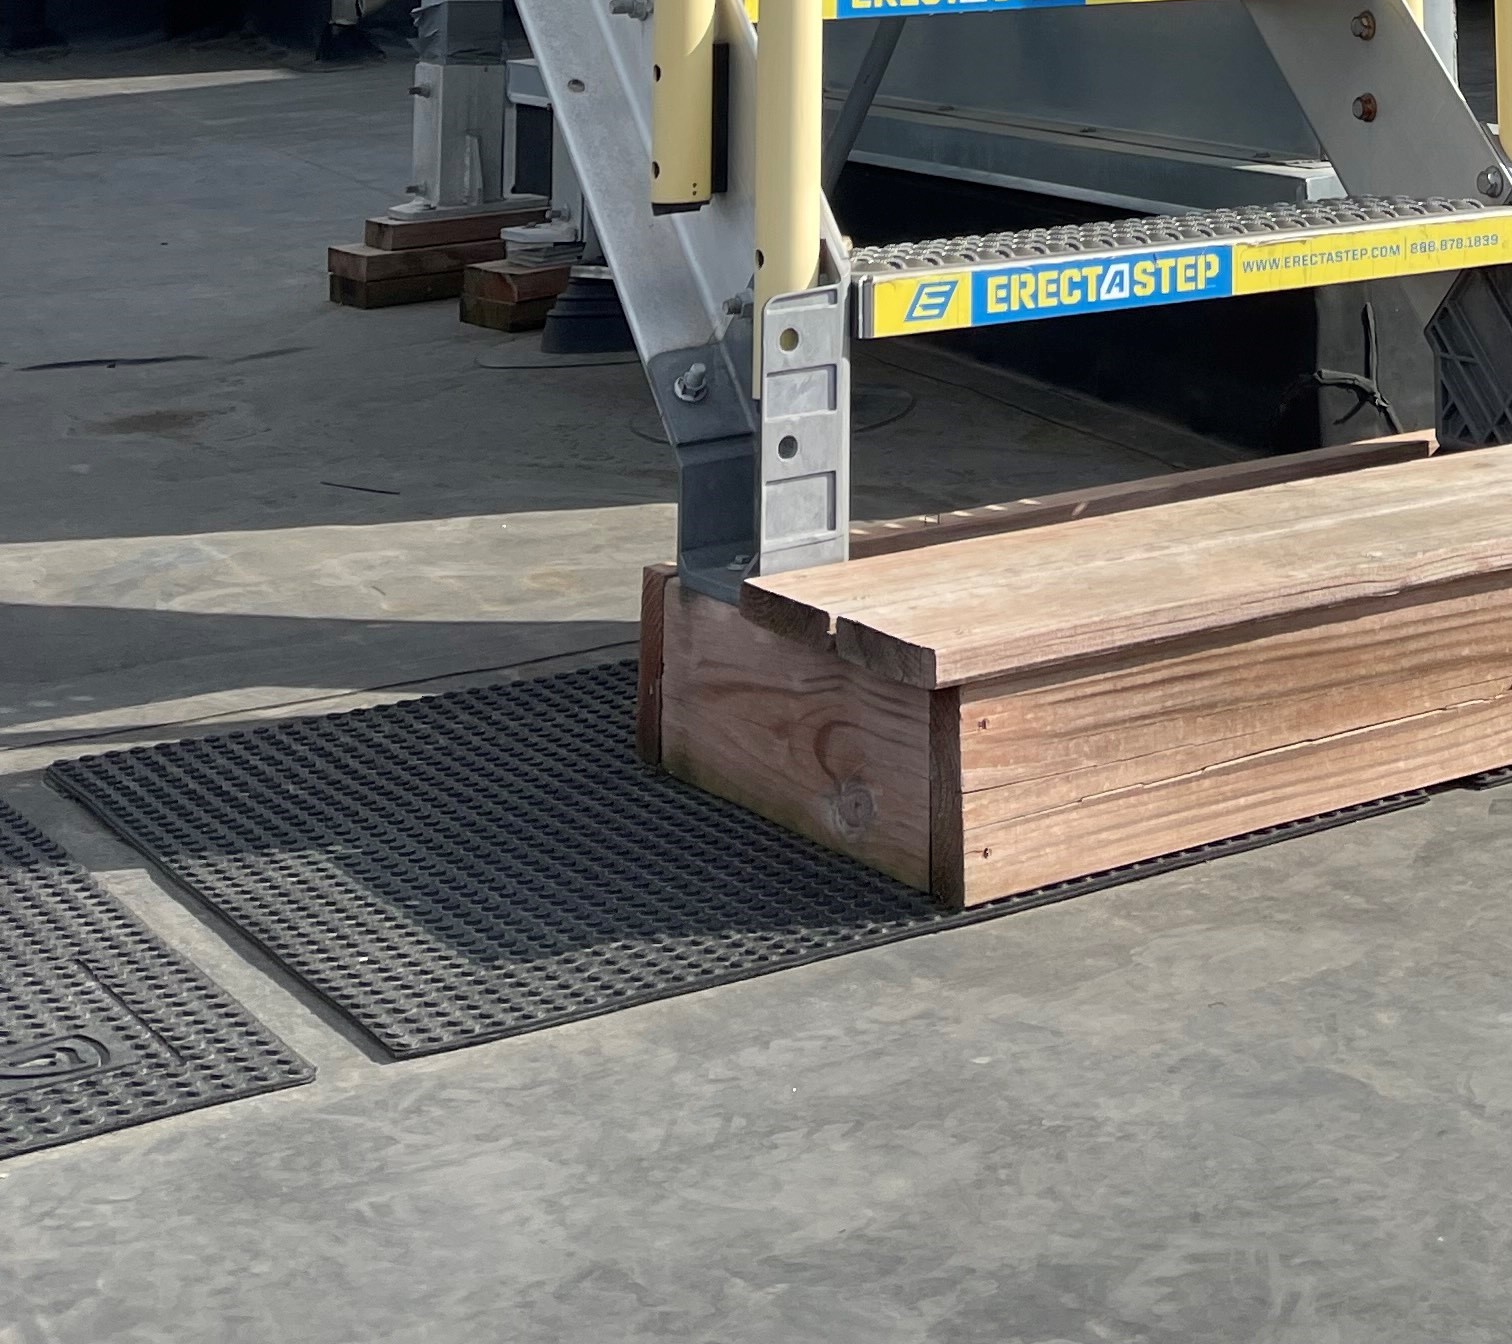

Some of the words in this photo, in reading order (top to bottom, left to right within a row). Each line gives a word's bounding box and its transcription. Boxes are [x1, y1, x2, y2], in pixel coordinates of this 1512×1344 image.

[986, 253, 1220, 314] ERECTASTEP
[1242, 244, 1400, 273] WWW.ERECTASTEP.COM
[1410, 233, 1499, 254] 888.878.1839
